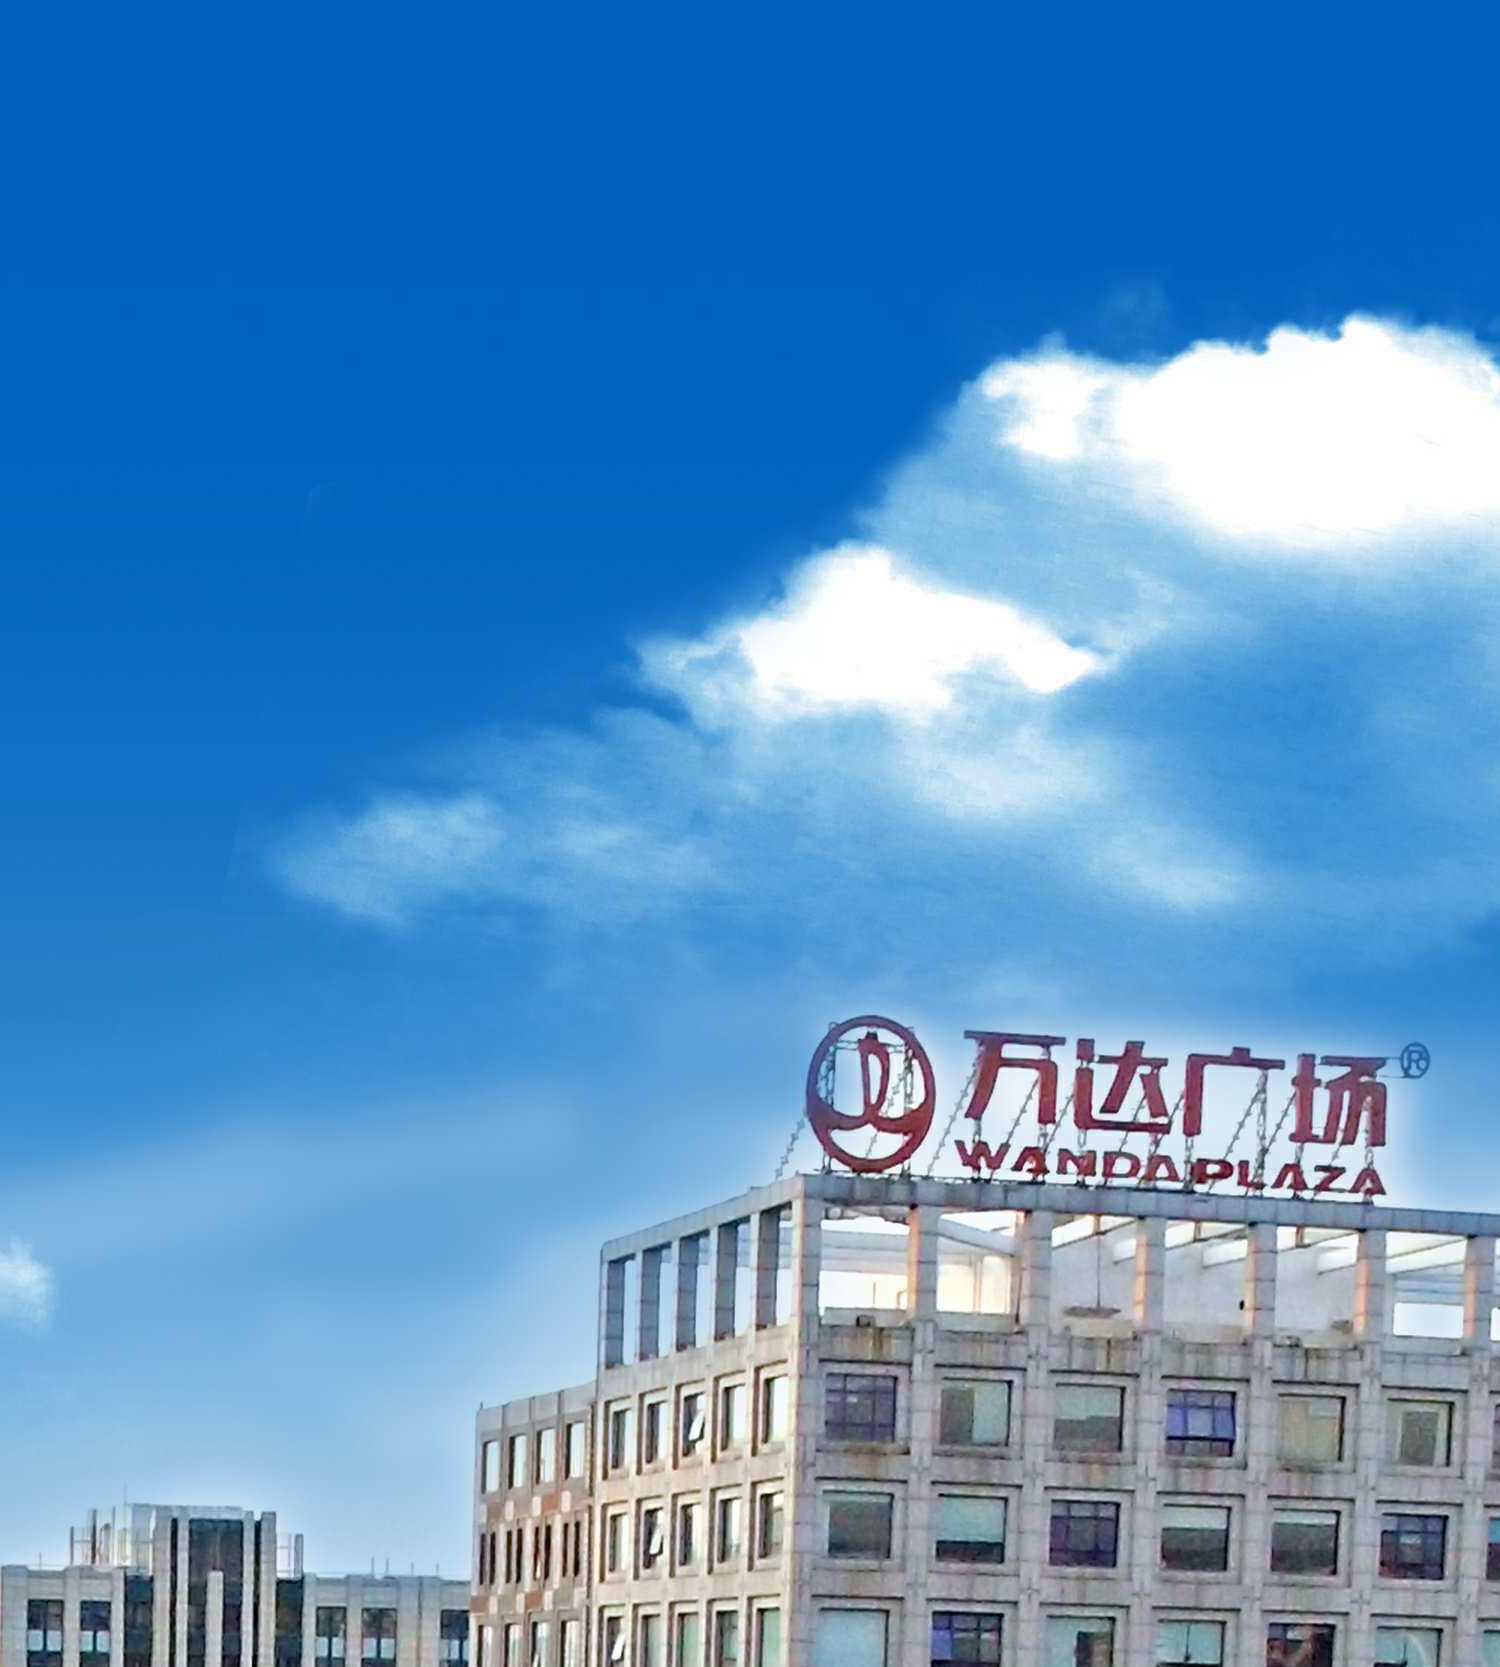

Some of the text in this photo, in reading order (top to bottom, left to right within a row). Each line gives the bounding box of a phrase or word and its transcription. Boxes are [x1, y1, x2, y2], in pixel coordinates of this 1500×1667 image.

[963, 1029, 1388, 1148] 万达广场
[953, 1139, 1388, 1197] WANDA PLAZA
